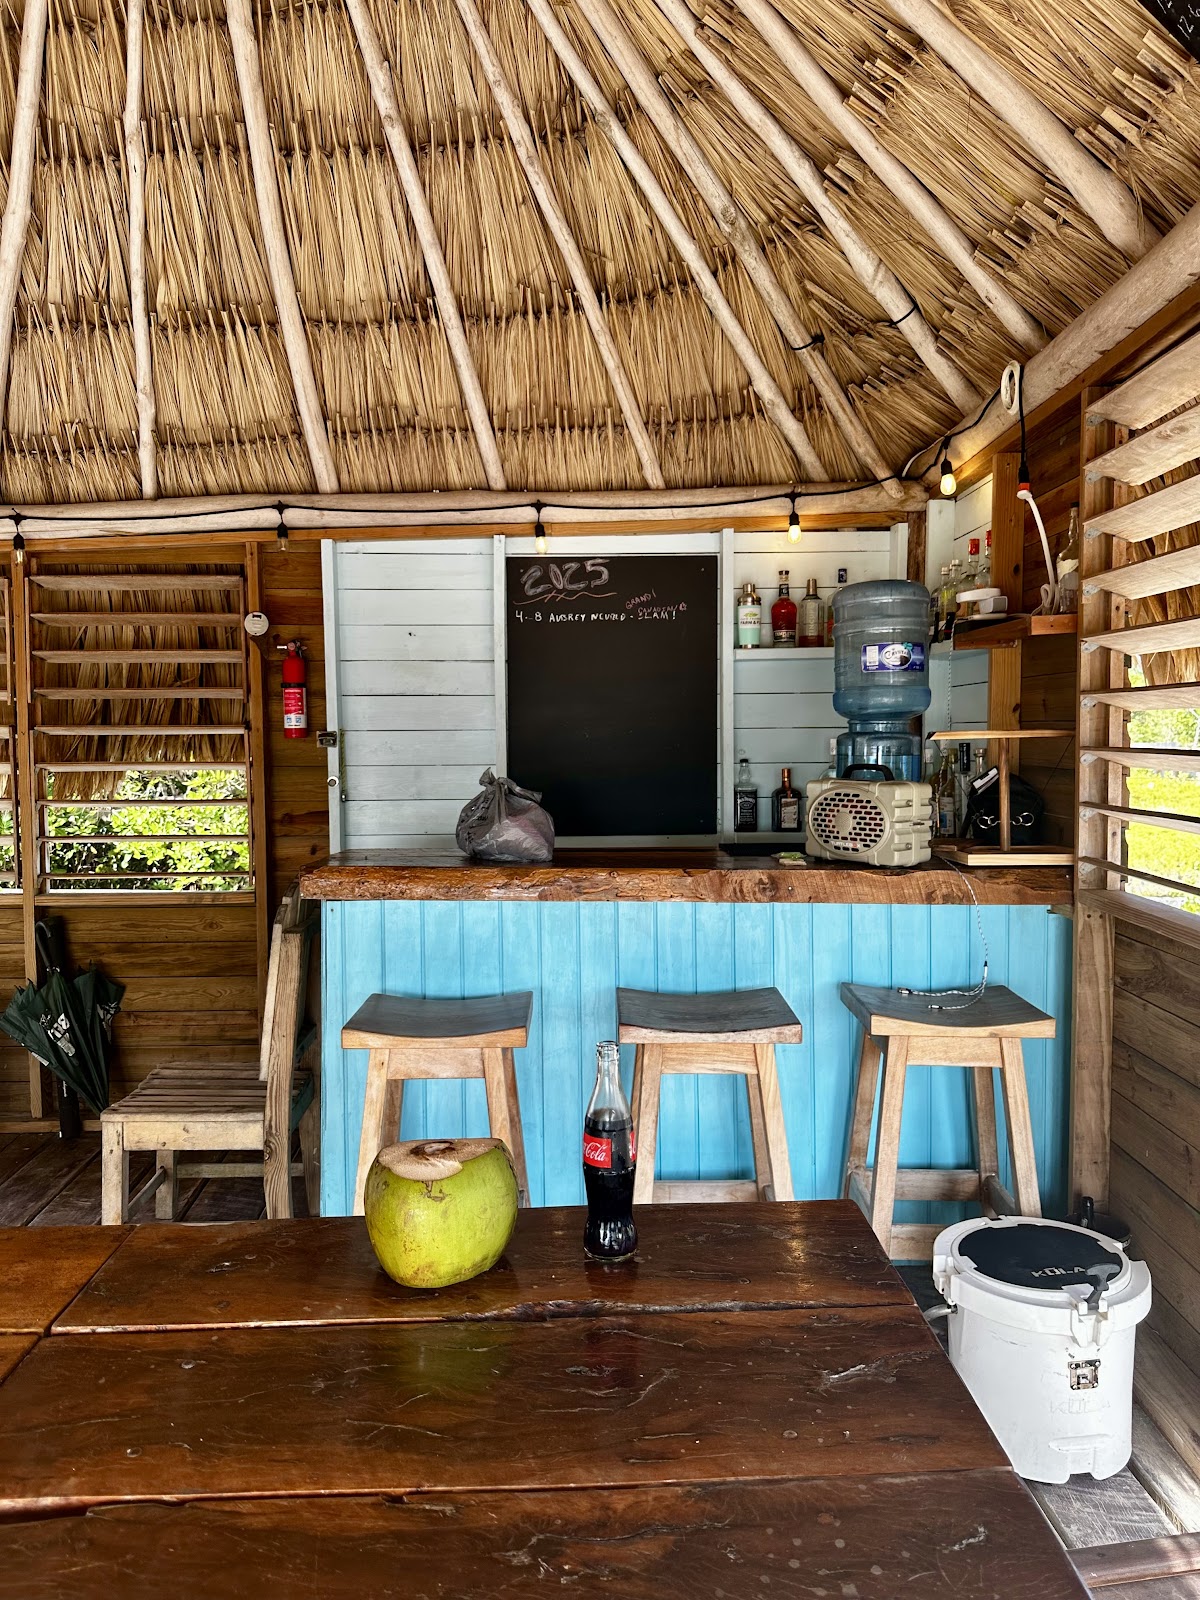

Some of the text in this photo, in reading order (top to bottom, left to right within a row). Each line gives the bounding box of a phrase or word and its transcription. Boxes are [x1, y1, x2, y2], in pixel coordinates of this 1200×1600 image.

[520, 558, 610, 596] 2025
[549, 613, 586, 623] AUBREY
[585, 1142, 608, 1162] Cola
